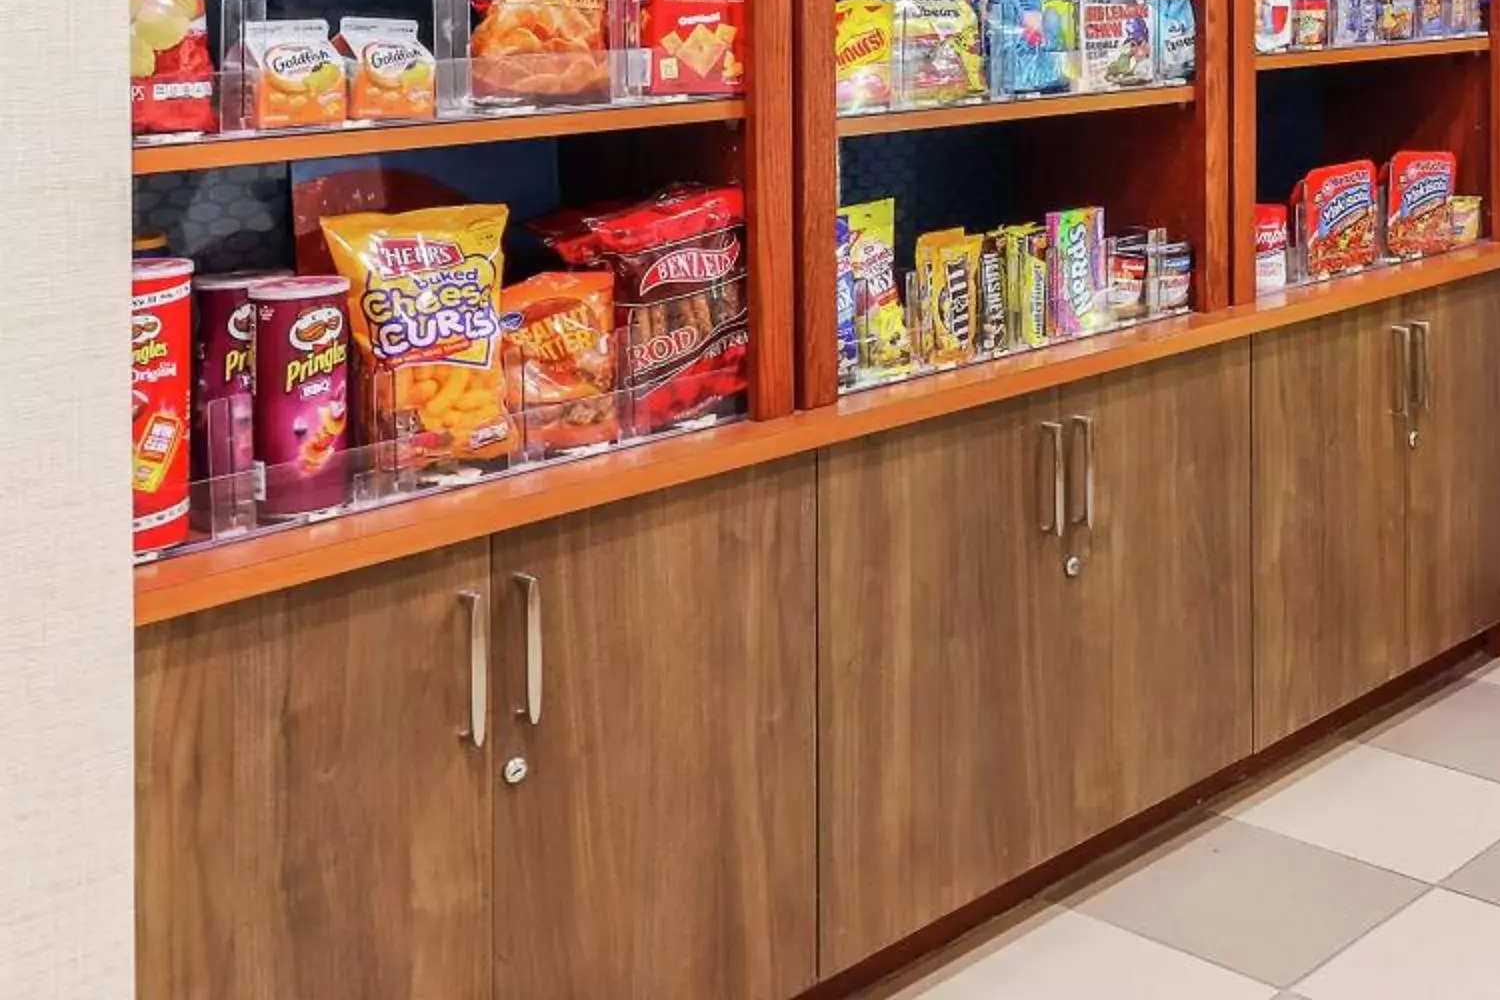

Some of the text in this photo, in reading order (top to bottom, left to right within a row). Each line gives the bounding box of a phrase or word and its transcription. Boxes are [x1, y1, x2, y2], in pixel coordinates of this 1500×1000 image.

[272, 49, 330, 74] Goldfish
[370, 47, 423, 70] Goldfish
[627, 326, 698, 370] ROD
[286, 342, 348, 393] Pringles
